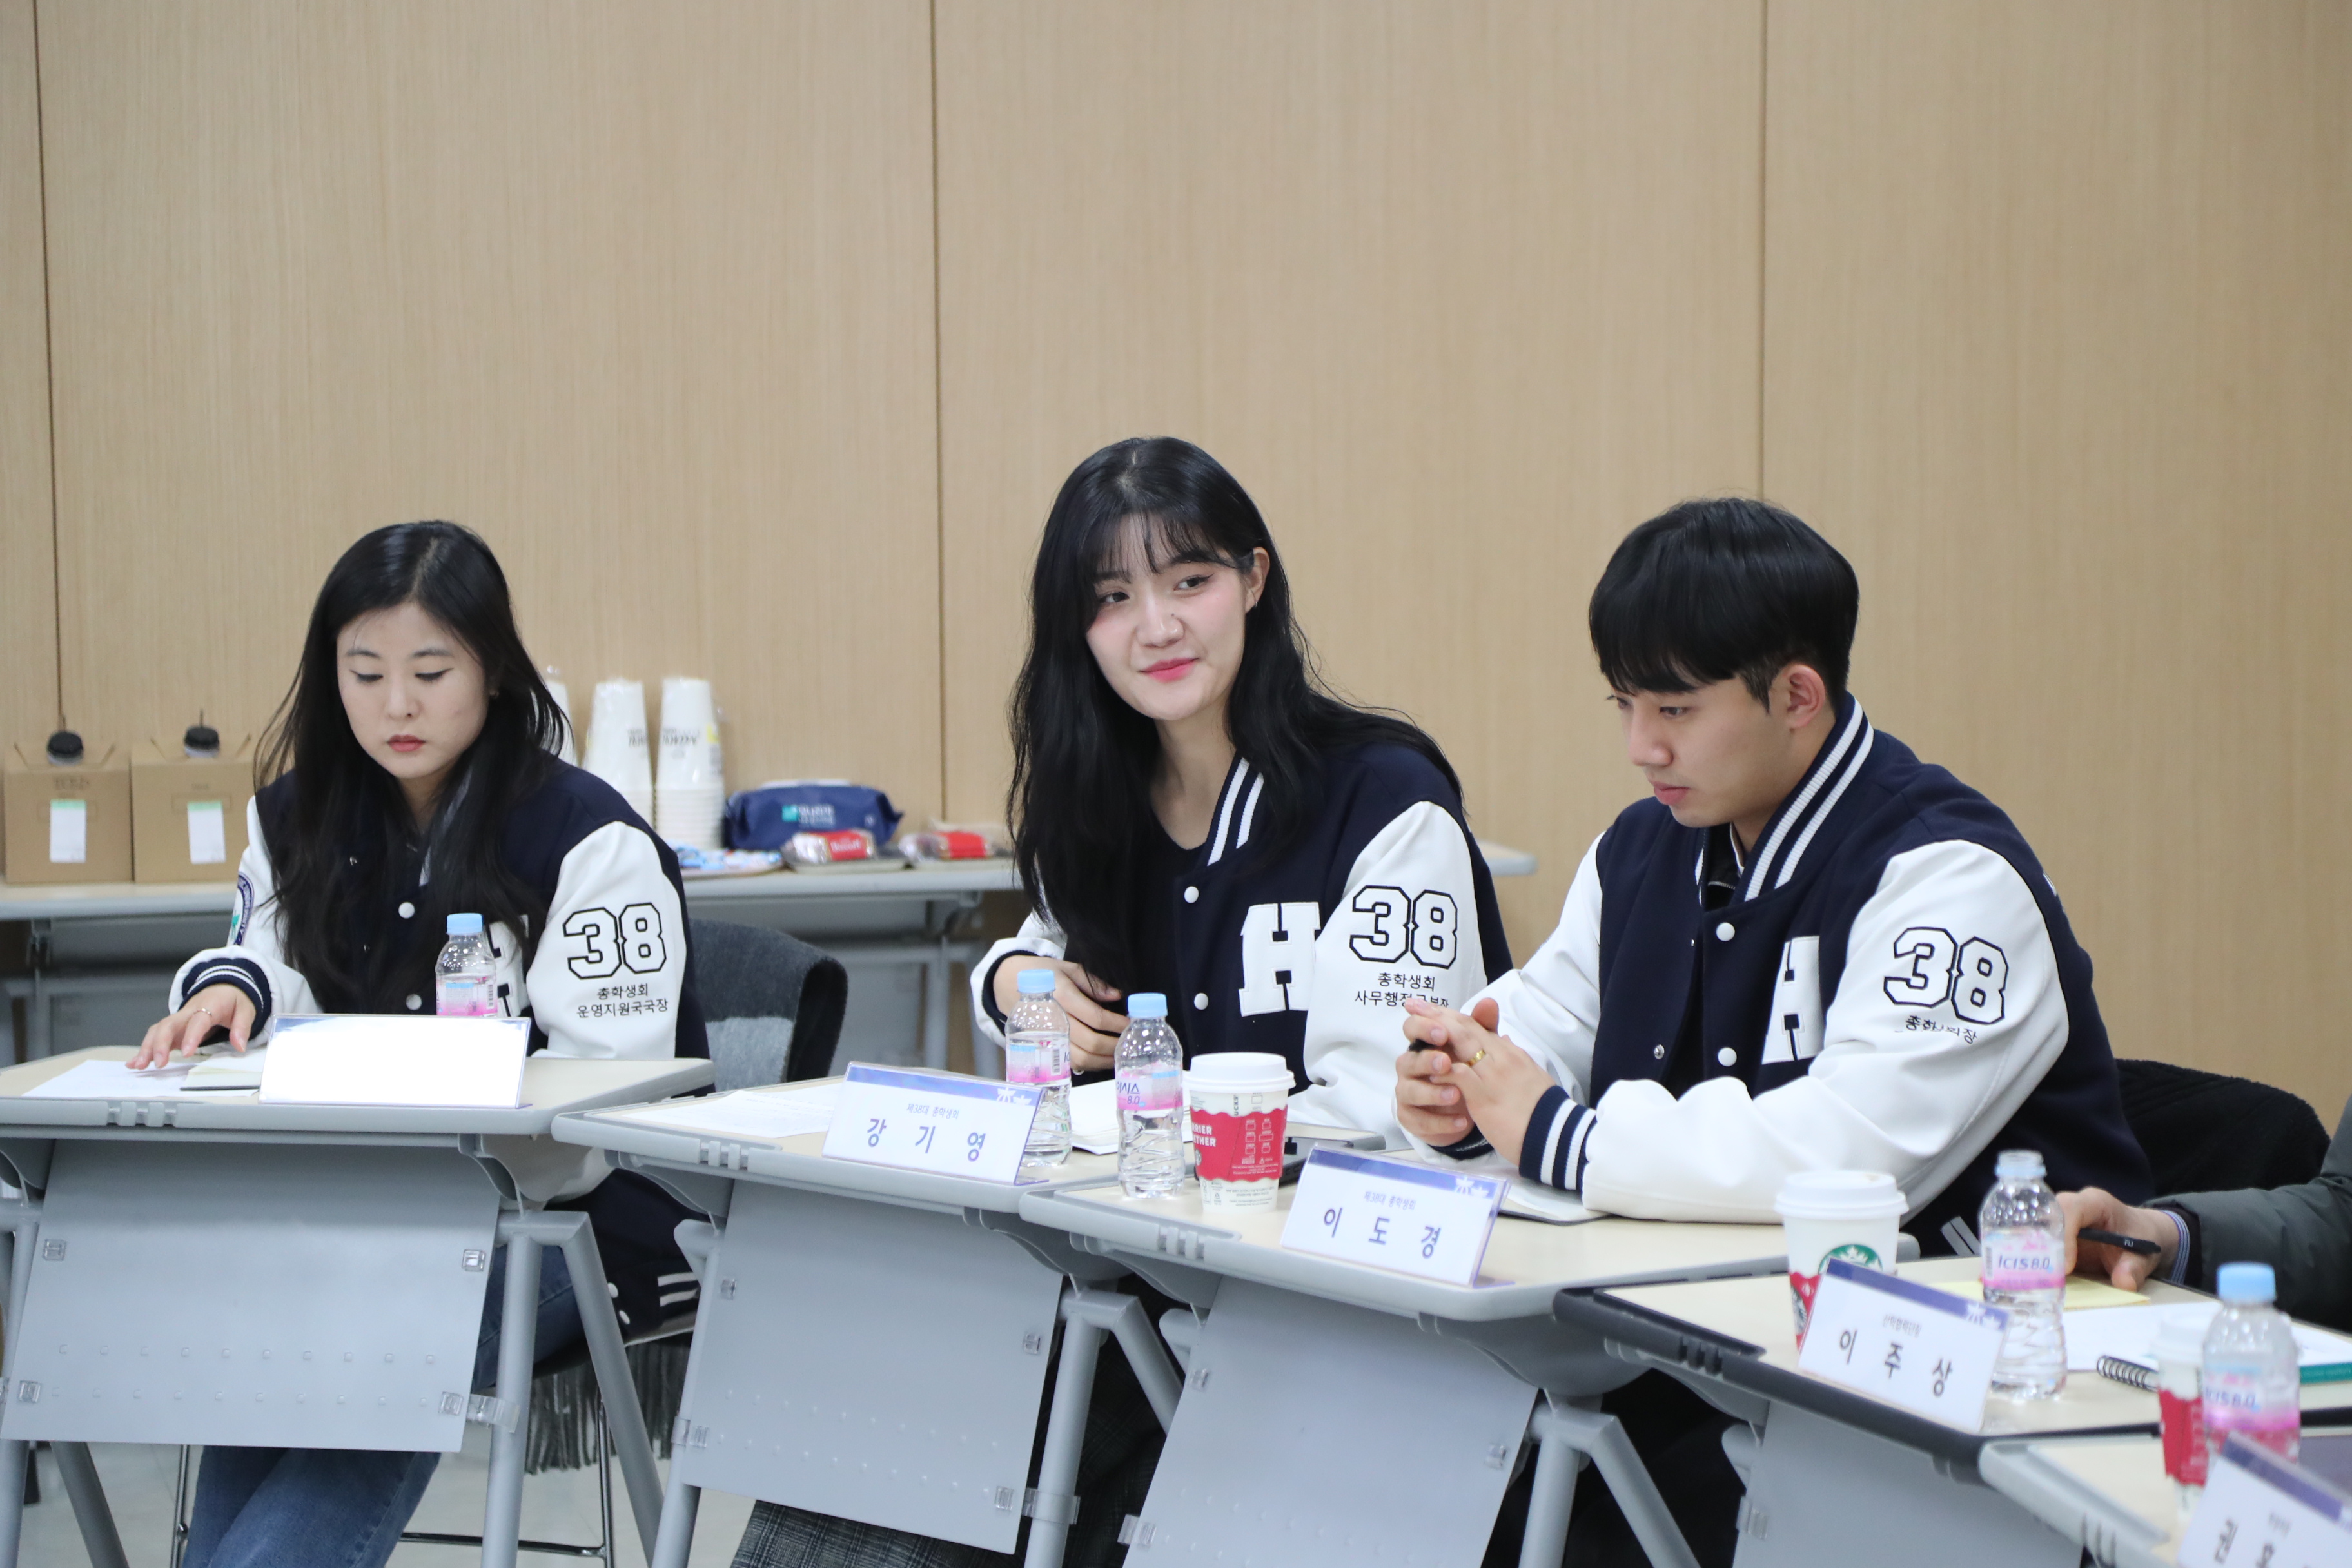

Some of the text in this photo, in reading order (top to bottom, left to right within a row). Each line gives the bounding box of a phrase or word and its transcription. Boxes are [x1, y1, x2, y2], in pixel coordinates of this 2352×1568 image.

[563, 902, 666, 979] 38
[1349, 885, 1458, 969] 38
[1239, 901, 1321, 1017] H
[1377, 972, 1435, 992] 총학생회
[1883, 926, 2008, 1025] 38
[576, 998, 669, 1018] 운영지원국국장
[597, 983, 649, 1000] 총학생회
[1127, 1095, 1140, 1105] 8.0
[867, 1118, 986, 1162] 강 기 영
[1324, 1207, 1441, 1259] 이 도 경
[1840, 1329, 1952, 1398] 이 주 상
